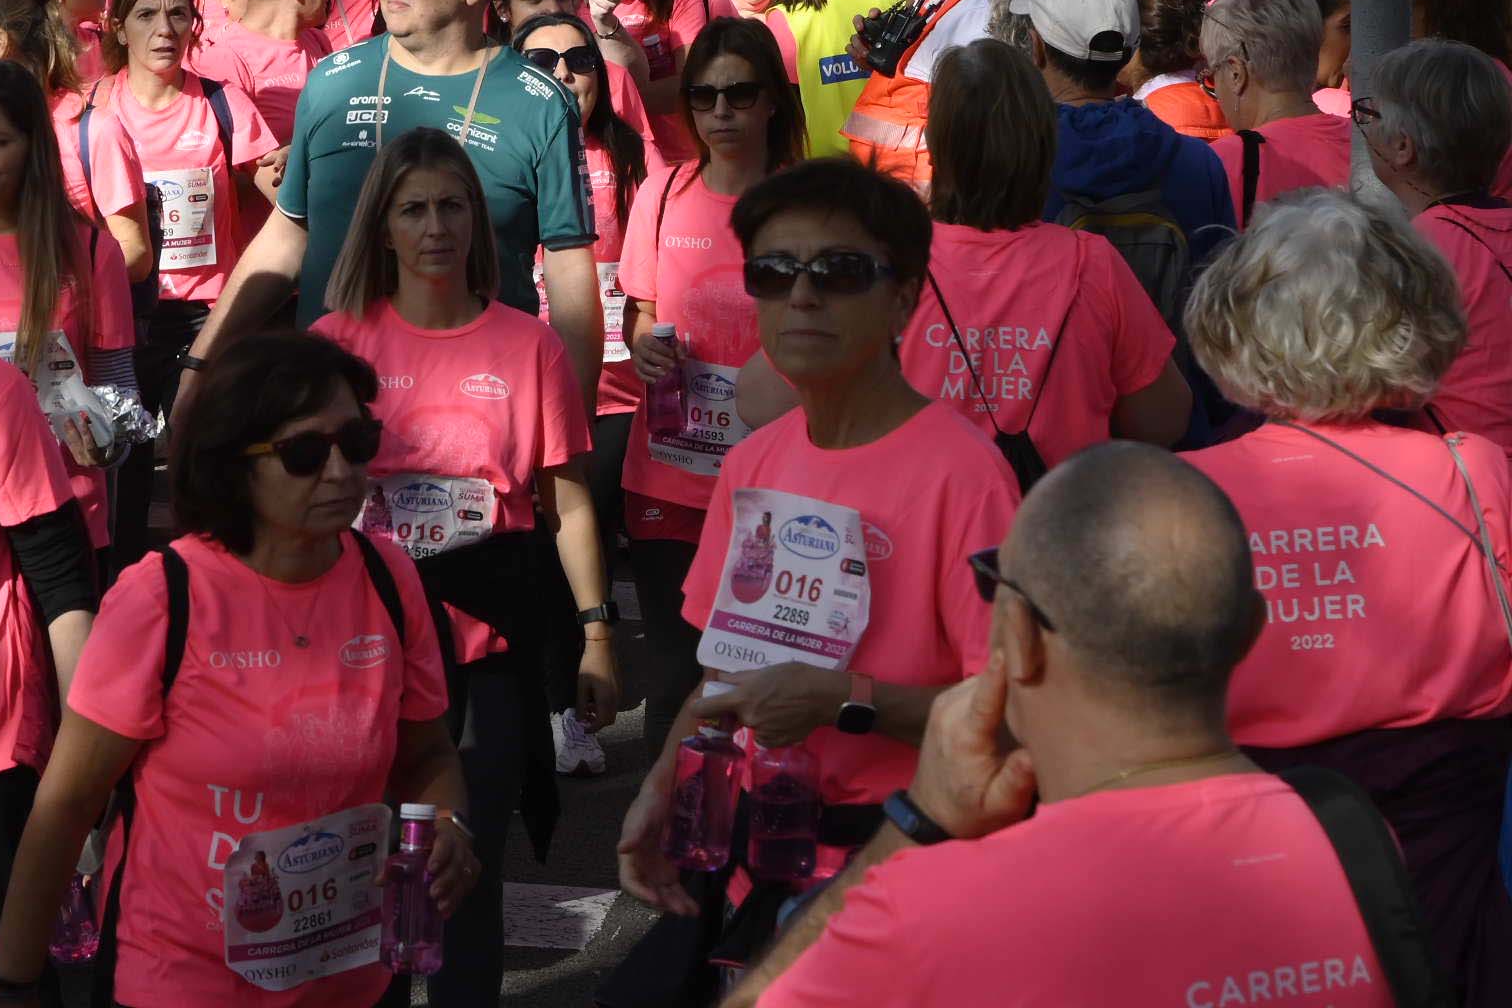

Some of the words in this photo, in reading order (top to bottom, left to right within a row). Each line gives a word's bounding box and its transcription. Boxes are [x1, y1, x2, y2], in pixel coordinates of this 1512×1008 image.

[325, 59, 362, 77] crypto.com
[519, 71, 554, 97] PERONI
[349, 95, 392, 105] aramco
[349, 111, 387, 123] JCB
[446, 121, 497, 144] cognizant
[171, 239, 192, 247] MUJER
[665, 235, 712, 249] OYSHO
[178, 251, 208, 260] Santander
[925, 323, 1053, 351] CARRERA
[949, 350, 983, 375] DE
[993, 350, 1028, 375] LA
[464, 382, 506, 396] ASTURIANA
[940, 375, 1033, 401] MUJER
[690, 407, 731, 427] 016
[662, 436, 693, 447] CARRERA
[692, 428, 725, 442] 21593
[396, 491, 449, 507] ASTURIANA
[457, 492, 486, 503] SUMA
[397, 522, 445, 543] 016
[782, 527, 836, 554] ASTURIANA
[775, 569, 824, 603] 016
[1255, 563, 1301, 591] DE
[1314, 560, 1357, 587] LA
[773, 603, 811, 627] 22859
[727, 619, 772, 638] CARRERA
[772, 630, 785, 642] DE
[785, 633, 797, 644] LA
[794, 634, 823, 652] MUJER
[1290, 632, 1336, 651] 2022
[209, 650, 282, 670] OYSHO
[714, 640, 766, 666] OYSHO
[206, 783, 265, 825] TU
[285, 844, 345, 870] ASTURIANA
[288, 878, 338, 913] 016
[293, 910, 334, 934] 22861
[244, 964, 297, 981] OYSHO
[331, 937, 381, 960] Santander
[247, 941, 294, 957] CARRERA
[1186, 953, 1373, 1008] CARRERA
